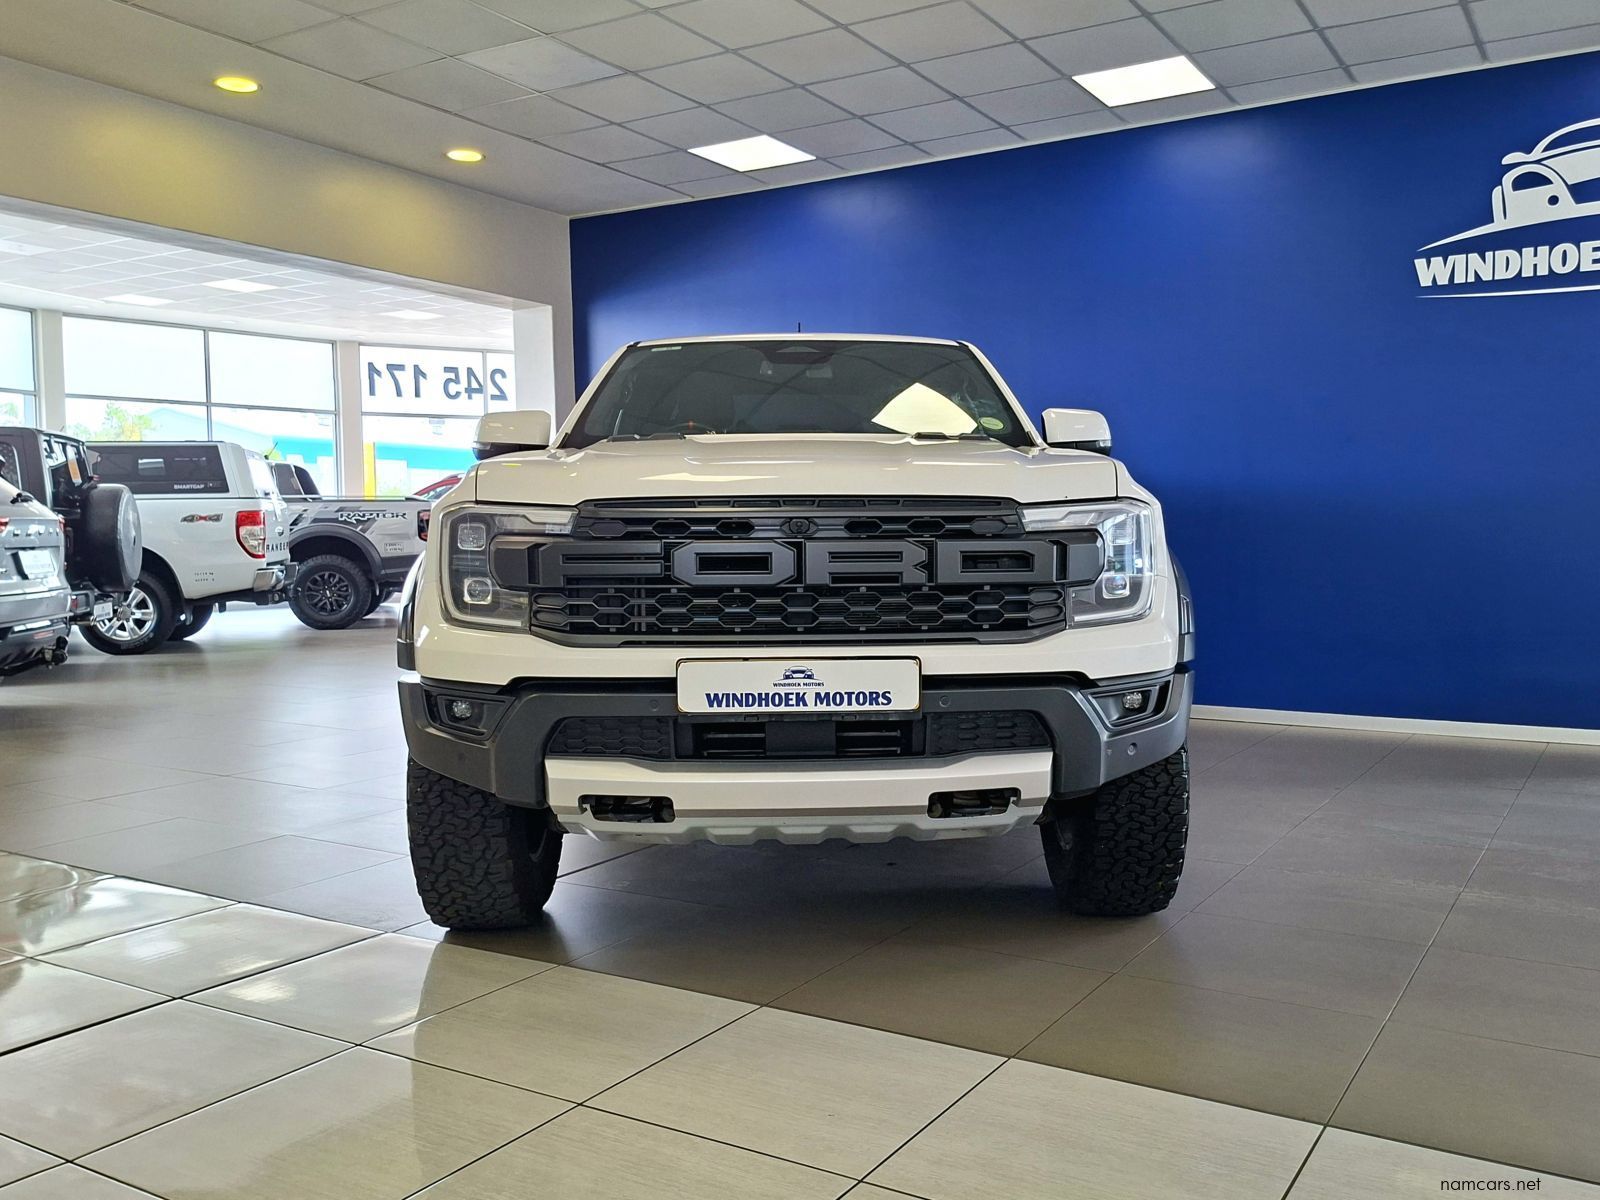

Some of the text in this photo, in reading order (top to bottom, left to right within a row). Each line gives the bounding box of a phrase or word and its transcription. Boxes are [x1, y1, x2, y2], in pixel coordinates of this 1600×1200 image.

[338, 511, 407, 524] RAPTOR
[539, 539, 1056, 586] FORD
[705, 690, 892, 708] WINDHOEK MOTORS
